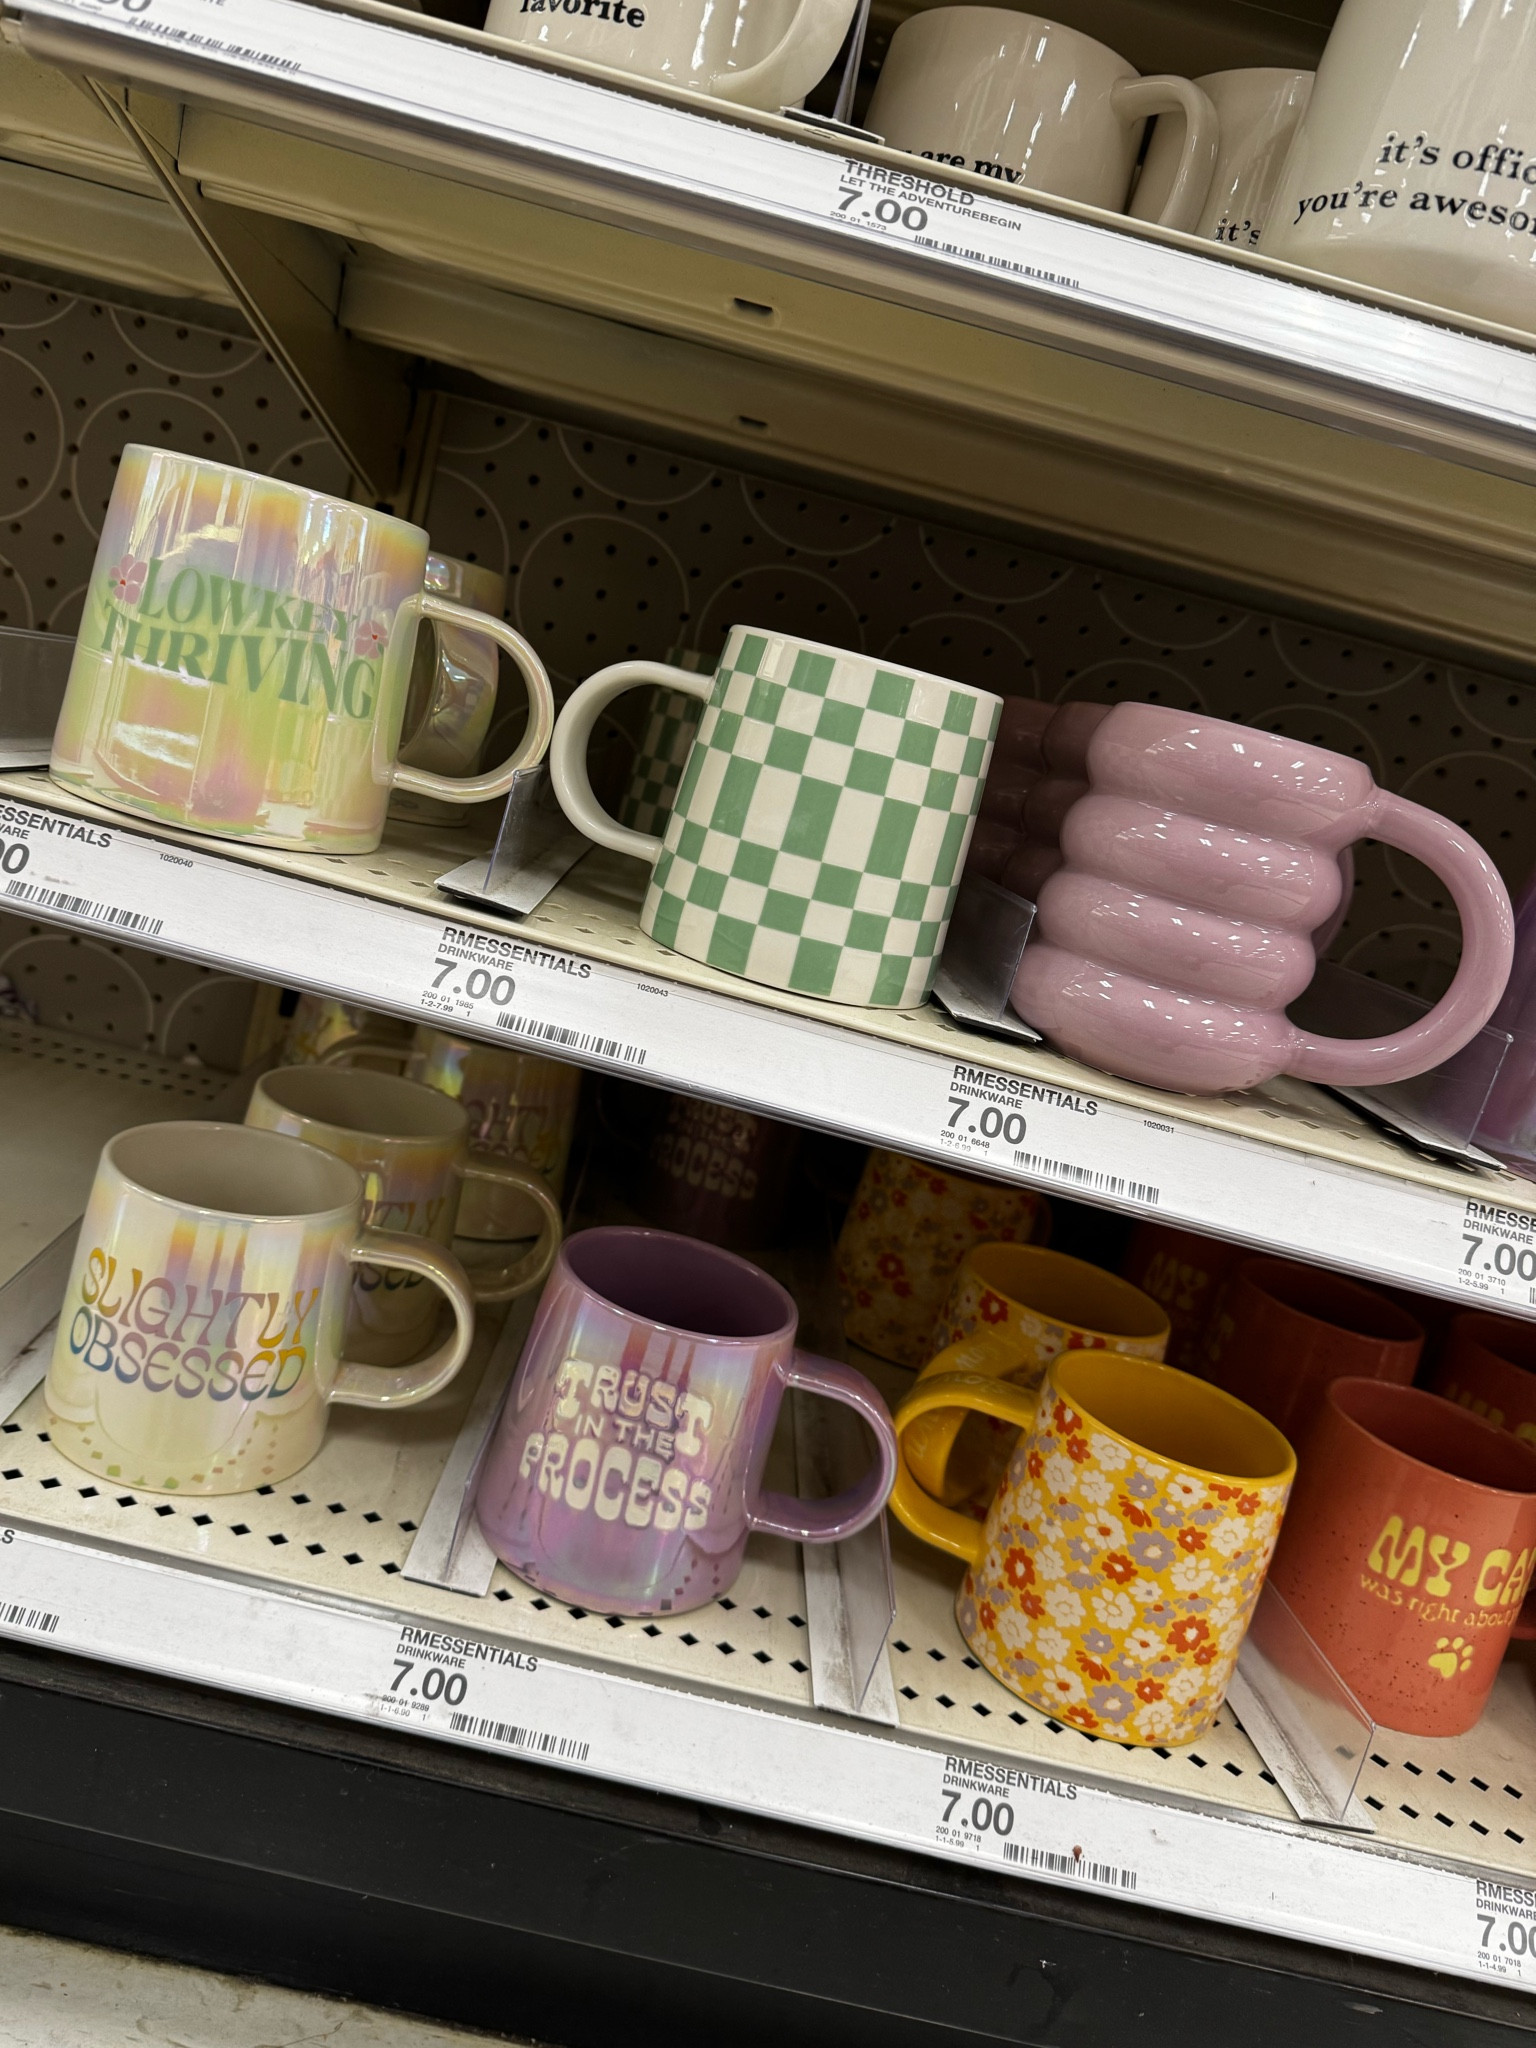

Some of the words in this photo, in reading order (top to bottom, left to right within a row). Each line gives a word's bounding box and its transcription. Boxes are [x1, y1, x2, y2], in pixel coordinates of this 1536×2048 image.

[840, 174, 858, 188] LET
[869, 182, 895, 197] THE
[898, 191, 1021, 231] ADVENTUREBEGIN
[844, 159, 975, 206] THRESHOLD
[837, 186, 928, 231] 7.00
[139, 557, 358, 642] LOWKEY
[100, 600, 375, 719] THRIVING
[159, 853, 194, 869] 1020040
[437, 943, 514, 972] DRINKWARE
[441, 926, 592, 979] RMESSENTIALS
[422, 990, 438, 1000] 200
[440, 994, 451, 1003] 01
[455, 999, 474, 1010] 1985
[431, 957, 516, 1006] 7.00
[636, 983, 669, 998] 1020043
[420, 998, 454, 1013] 1-2-7.99
[950, 1081, 1023, 1109] DRINKWARE
[952, 1065, 1098, 1116] RMESSENTIALS
[940, 1129, 955, 1139] 200
[957, 1134, 967, 1143] 01
[971, 1138, 990, 1149] 6648
[947, 1096, 1027, 1145] 7.00
[1142, 1119, 1175, 1134] 1020031
[1463, 1218, 1534, 1245] DRINKWARE
[1458, 1268, 1472, 1278] 200
[1474, 1272, 1484, 1281] 01
[1487, 1275, 1506, 1287] 3710
[1462, 1233, 1536, 1281] 7.00
[81, 1247, 321, 1349] SLIGHTLY
[555, 1358, 713, 1457] TRUST
[574, 1413, 605, 1438] IN
[613, 1418, 676, 1464] THE
[519, 1432, 712, 1531] PROCESS
[1367, 1515, 1471, 1597] MY
[1361, 1573, 1402, 1606] was
[1408, 1596, 1461, 1622] right
[396, 1644, 467, 1669] DRINKWARE
[400, 1626, 538, 1672] RMESSENTIALS
[389, 1658, 468, 1706] 7.00
[942, 1774, 1010, 1798] DRINKWARE
[945, 1756, 1077, 1801] RMESSENTIALS
[936, 1825, 949, 1835] 200
[952, 1829, 961, 1838] 01
[964, 1832, 981, 1843] 9718
[941, 1789, 1014, 1836] 7.00
[1478, 1951, 1490, 1960] 200
[1493, 1955, 1501, 1963] 01
